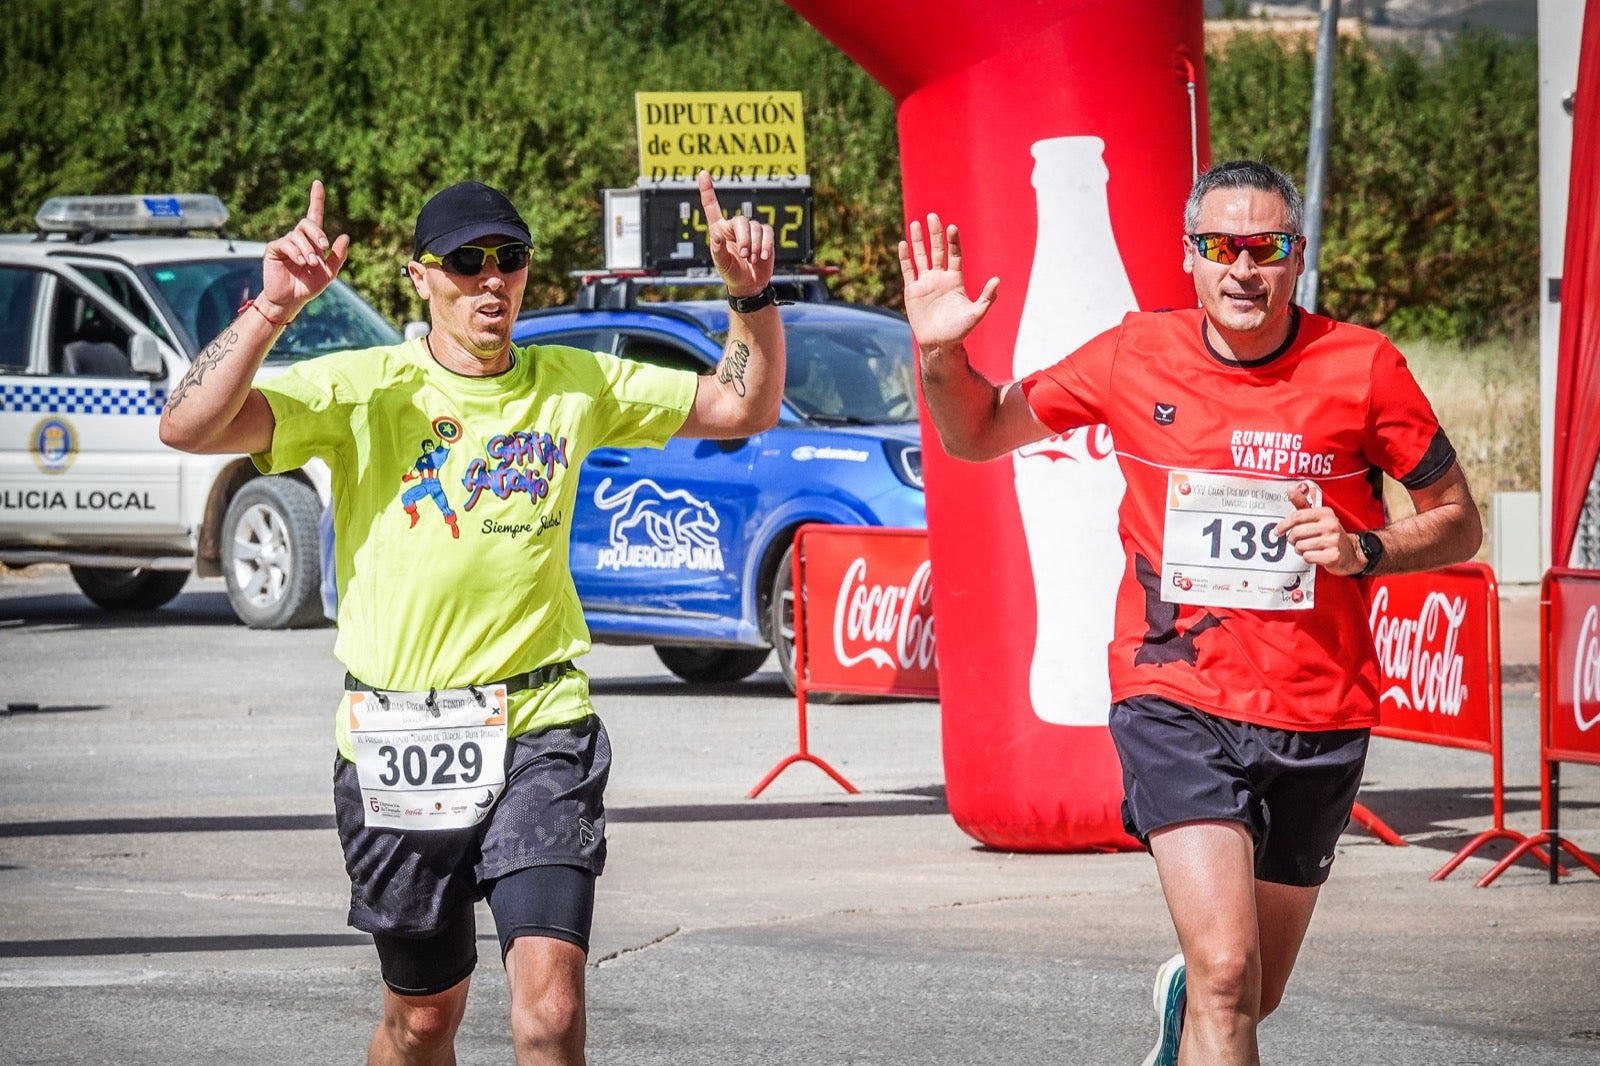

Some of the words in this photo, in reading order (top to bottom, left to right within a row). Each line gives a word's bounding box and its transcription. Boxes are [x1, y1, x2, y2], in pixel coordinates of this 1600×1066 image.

[646, 96, 795, 125] DIPUTACIÓN
[648, 134, 671, 155] de
[678, 132, 797, 155] GRANADA
[651, 163, 799, 183] DEPORTES
[1231, 430, 1303, 450] RUNNING
[1231, 446, 1334, 475] VAMPIROS
[76, 491, 156, 510] LOCAL
[481, 518, 533, 539] Siempre
[1202, 518, 1288, 563] 139
[378, 742, 483, 787] 3029
